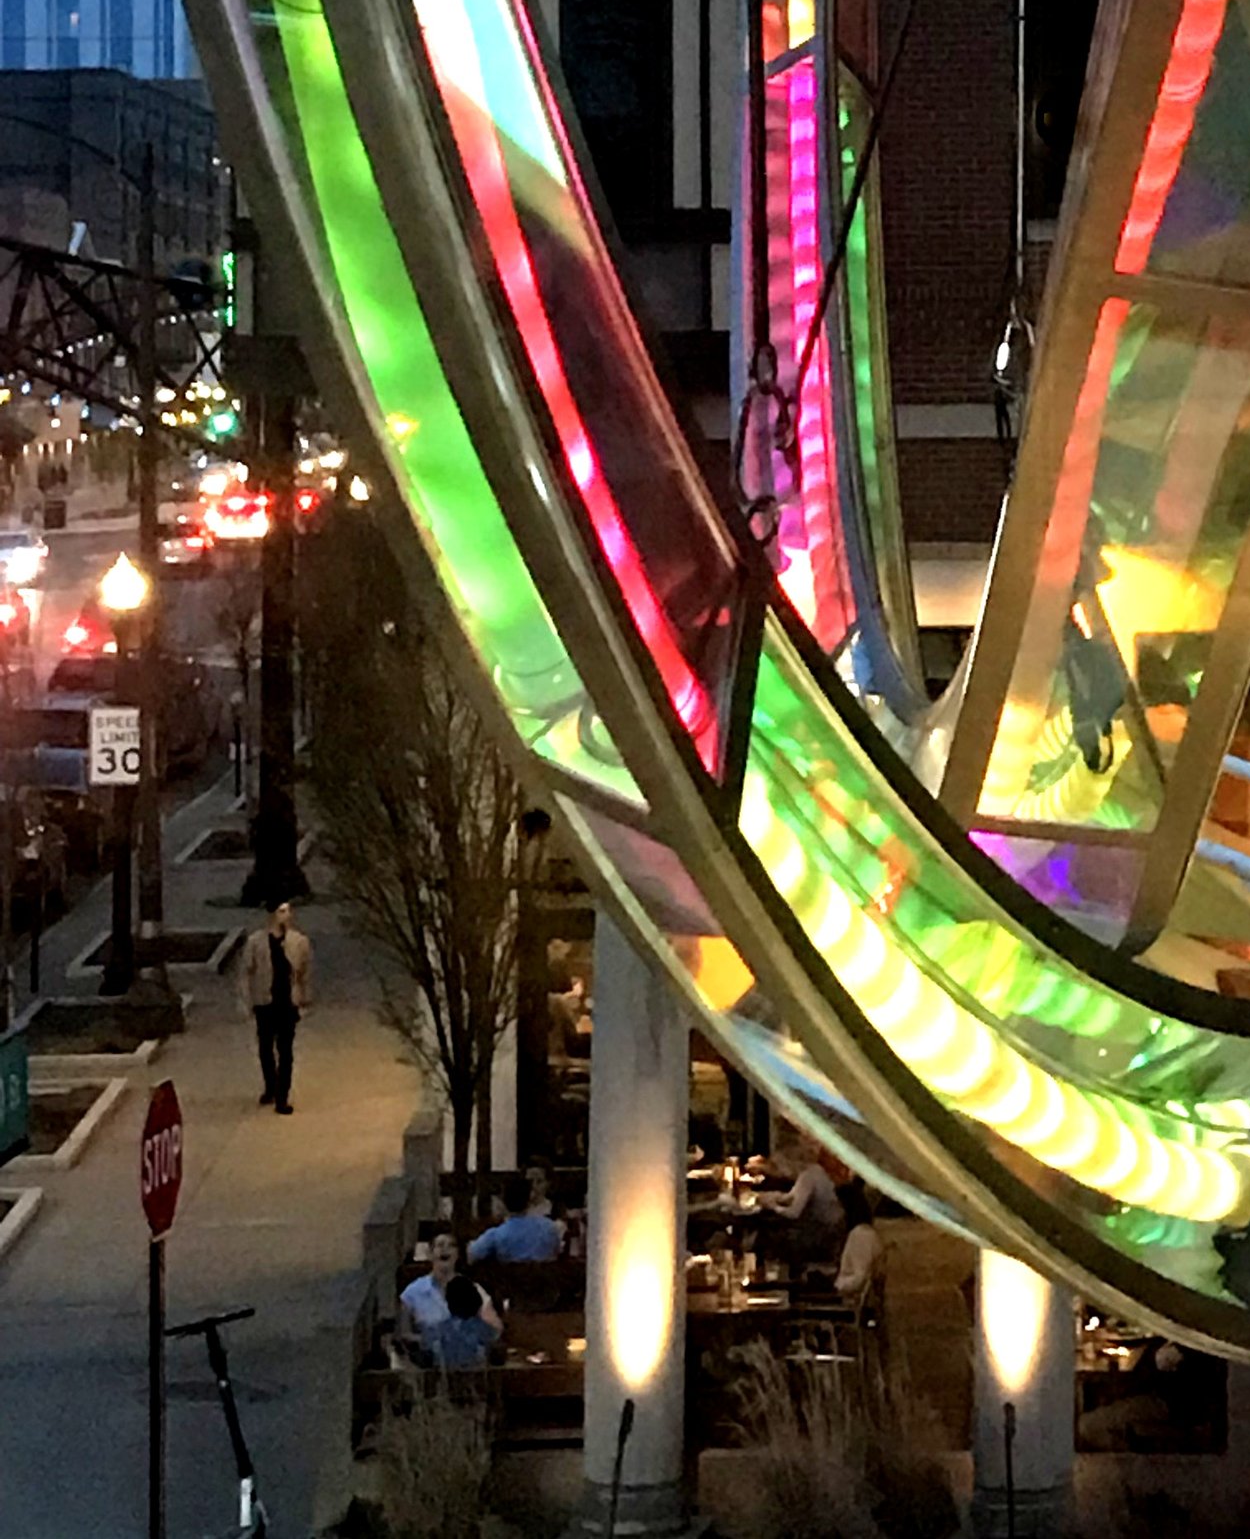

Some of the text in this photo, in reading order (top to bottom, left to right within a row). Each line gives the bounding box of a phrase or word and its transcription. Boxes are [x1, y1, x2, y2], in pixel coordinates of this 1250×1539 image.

[96, 716, 140, 728] SPEE
[101, 731, 140, 744] LIMIT
[98, 747, 140, 774] 30
[143, 1124, 181, 1194] STOP
